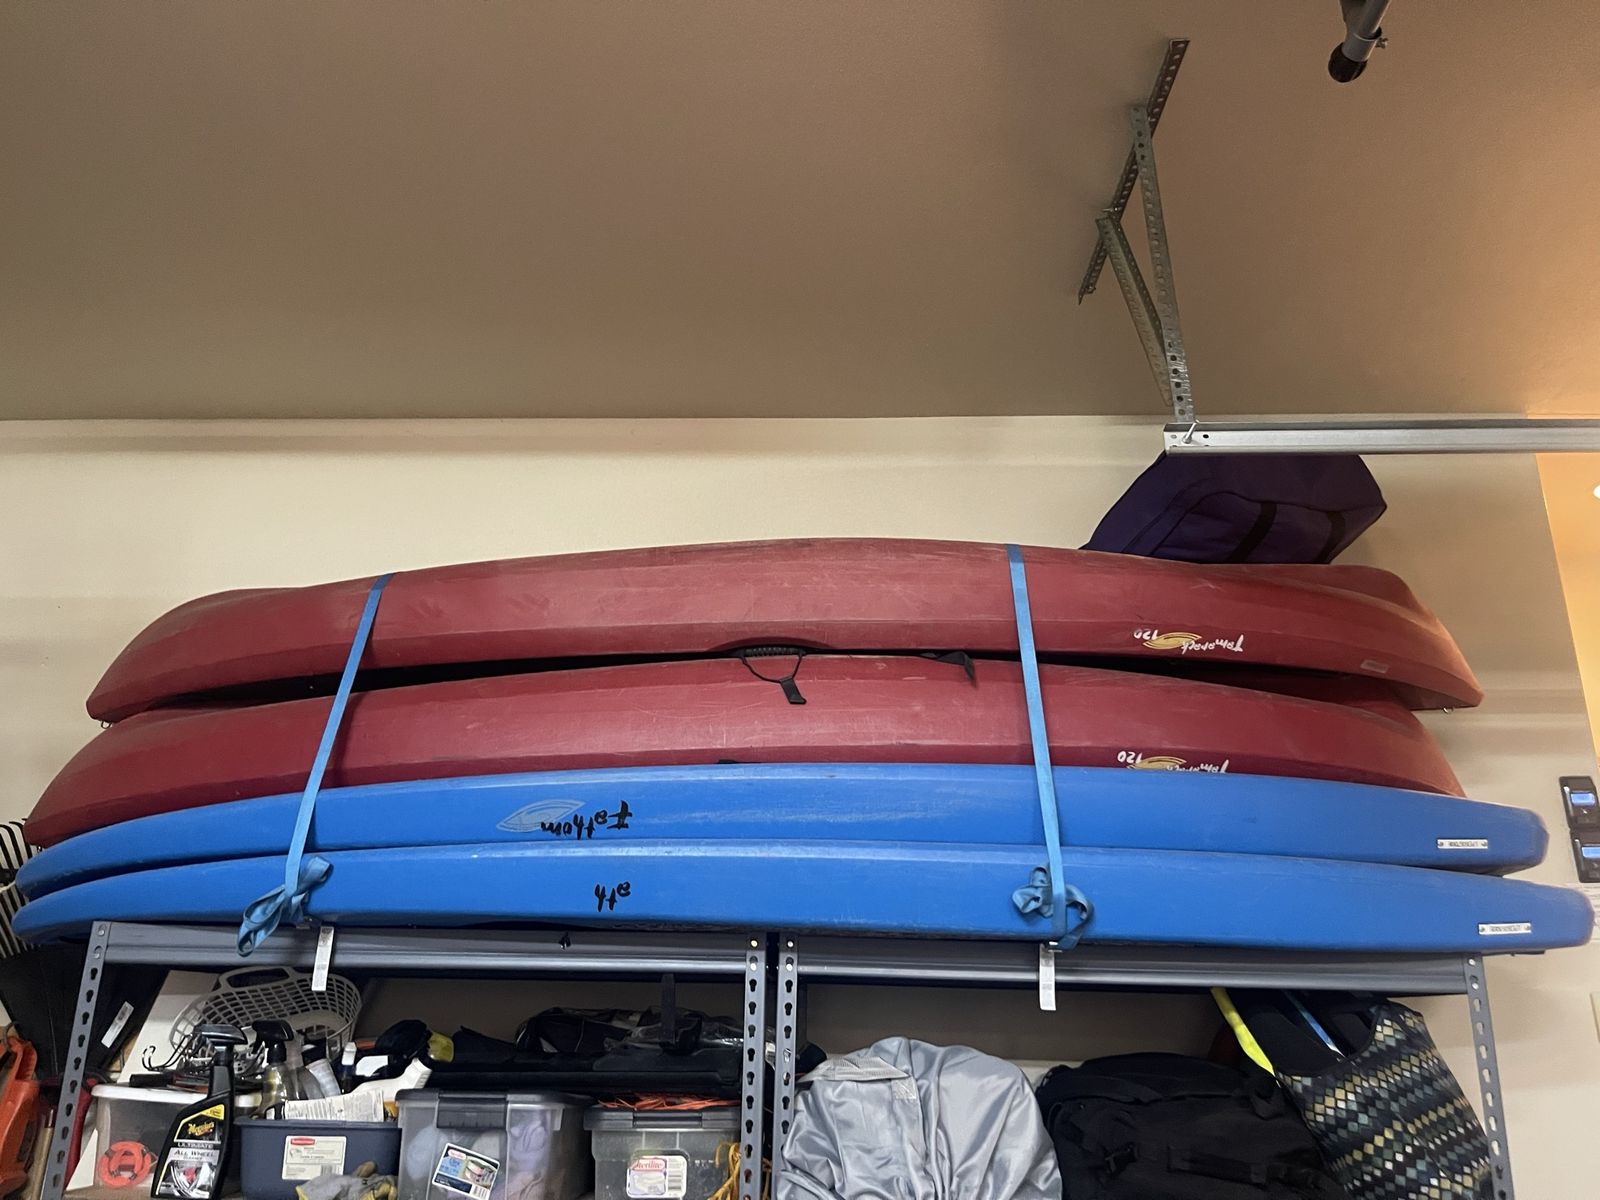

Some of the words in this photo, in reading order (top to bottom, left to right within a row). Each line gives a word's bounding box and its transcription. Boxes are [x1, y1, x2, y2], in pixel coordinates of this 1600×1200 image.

[1133, 630, 1159, 641] 120
[1180, 634, 1244, 655] Tamarack
[1117, 750, 1143, 764] 120
[540, 800, 633, 841] Fathom
